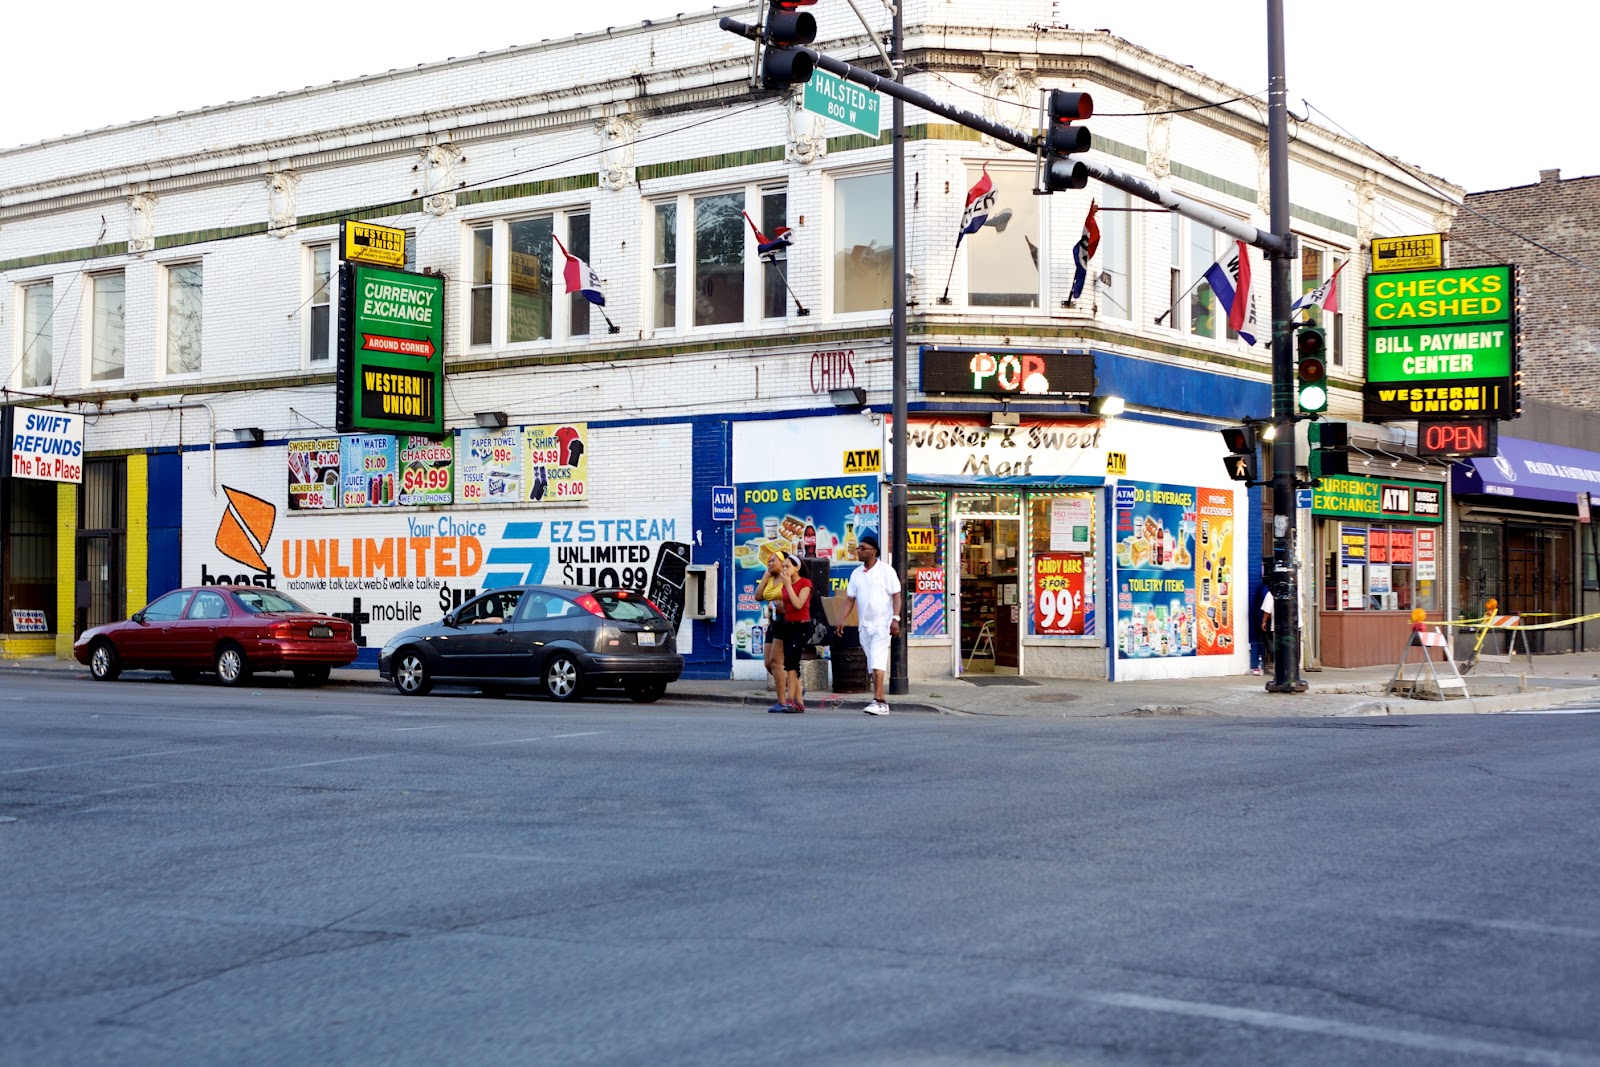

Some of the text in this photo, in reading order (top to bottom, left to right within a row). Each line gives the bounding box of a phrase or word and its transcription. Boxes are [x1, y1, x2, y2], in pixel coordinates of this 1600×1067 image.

[815, 74, 866, 110] HALSTED
[868, 98, 878, 112] ST
[827, 101, 857, 123] 800 W
[355, 227, 400, 243] WESTERN
[369, 238, 400, 252] UNION
[1379, 239, 1433, 251] WESTERN
[1395, 247, 1433, 257] UNION
[364, 282, 434, 307] CURRENCY
[1375, 275, 1502, 299] CHECKS
[363, 299, 433, 323] EXCHANGE
[1374, 297, 1502, 320] CASHED
[369, 338, 430, 354] AROUND CORNER
[1375, 331, 1504, 354] BILL PAYMENT
[809, 349, 856, 394] CHIPS
[1402, 354, 1474, 375] CENTER
[365, 371, 421, 396] WESTERN
[1379, 386, 1480, 402] WESTERN
[383, 394, 421, 416] UNION
[1410, 399, 1480, 413] UNION
[25, 413, 71, 434] SWIFT
[363, 438, 387, 449] WATER
[471, 437, 516, 448] PAPER TOWEL
[527, 436, 558, 450] T-SHIRT
[1000, 427, 1016, 448] &
[1027, 425, 1101, 451] Sweet
[1425, 425, 1483, 450] OPEN
[12, 434, 82, 457] REFUNDS
[289, 440, 339, 452] SWISHER SWEET
[318, 454, 339, 465] $1.00
[401, 448, 452, 462] CHARGERS
[532, 450, 559, 464] $4.99
[845, 450, 880, 468] ATM
[1107, 452, 1127, 470] ATM
[14, 454, 81, 480] The Tax Place
[365, 457, 386, 470] $1.00
[463, 465, 477, 473] SCOTT
[960, 453, 1034, 478] Mart
[345, 476, 364, 486] JUICE
[404, 469, 448, 491] $4.99
[463, 472, 484, 482] TISSUE
[547, 467, 571, 480] SOCKS
[290, 485, 313, 493] SMOKERS
[557, 482, 584, 497] $1.00
[745, 483, 868, 504] FOOD & BEVERAGES
[1117, 490, 1134, 498] ATM
[1315, 478, 1379, 497] CURRENCY
[345, 493, 365, 505] $1.00
[425, 494, 451, 502] PHONES
[714, 493, 734, 504] ATM
[1145, 490, 1152, 503] &
[1153, 490, 1192, 506] BEVERAGES
[1382, 487, 1410, 512] ATM
[1416, 491, 1437, 502] DIRECT
[714, 506, 734, 514] Inside
[853, 504, 878, 515] ATM
[1314, 495, 1380, 514] EXCHANGE
[407, 515, 487, 537] Your Choice
[282, 535, 483, 578] UNLIMITED
[557, 545, 650, 563] UNLIMITED
[1037, 559, 1082, 574] CANDY BARS
[918, 570, 942, 581] NOW
[286, 578, 327, 590] nationwide
[389, 578, 414, 590] walkie
[416, 578, 440, 590] talkie
[743, 585, 754, 593] WE
[918, 580, 942, 591] OPEN
[1042, 579, 1066, 588] 2 FOR
[1128, 579, 1185, 592] TOILETRY ITEMS
[372, 601, 421, 621] mobile
[737, 603, 760, 611] PHONES
[1039, 588, 1081, 628] 99¢
